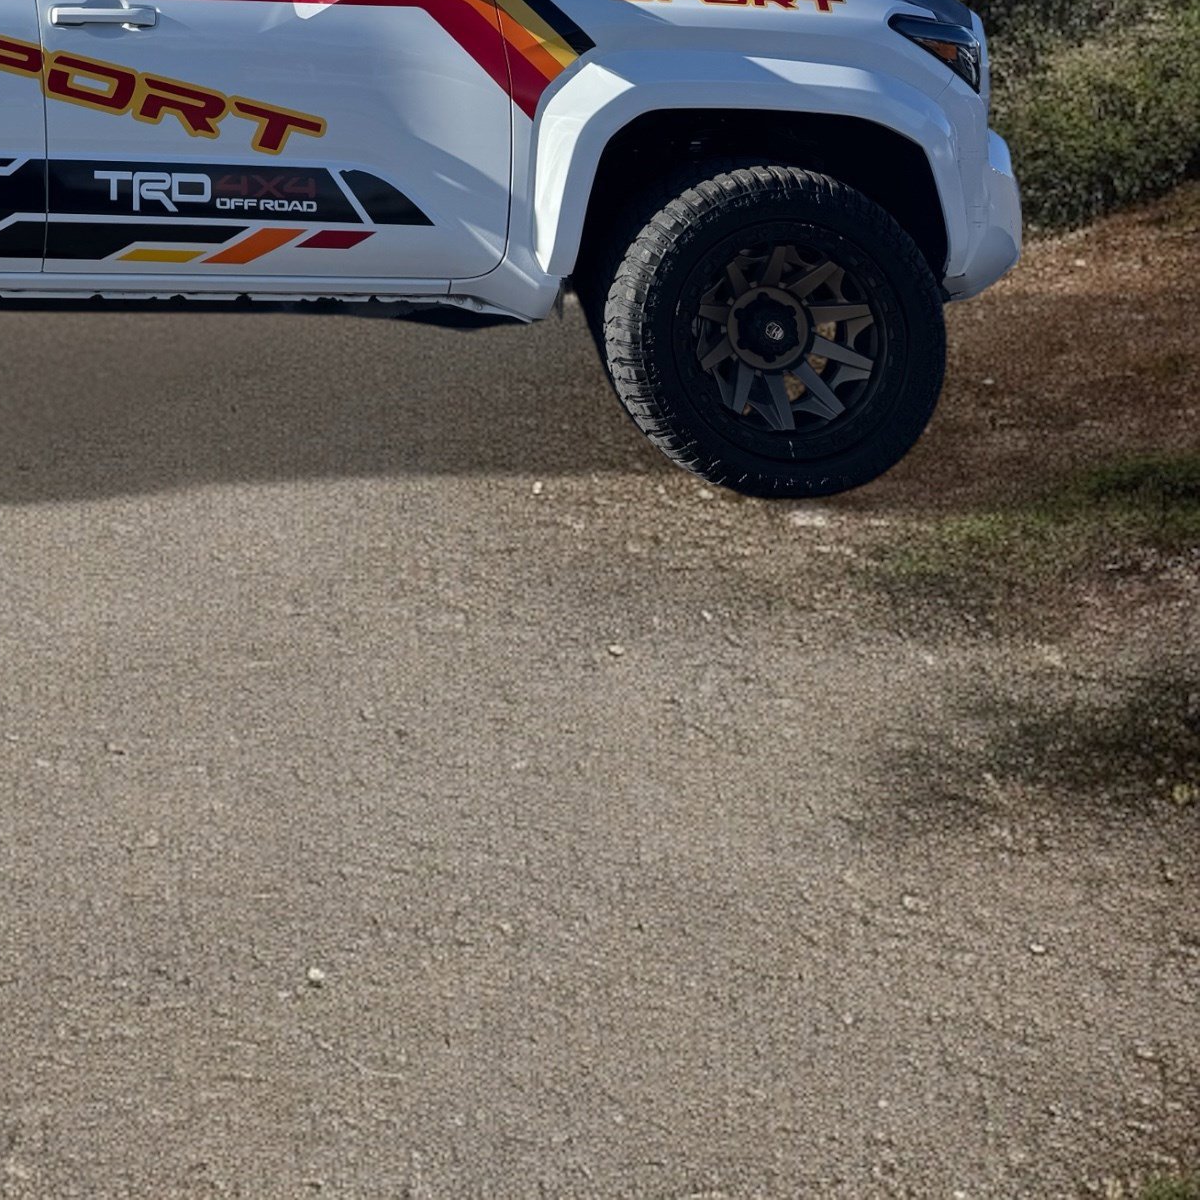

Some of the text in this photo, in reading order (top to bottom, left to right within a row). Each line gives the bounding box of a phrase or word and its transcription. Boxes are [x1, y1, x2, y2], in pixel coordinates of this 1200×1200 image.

[94, 170, 211, 213] TRD
[215, 198, 318, 213] OFF ROAD
